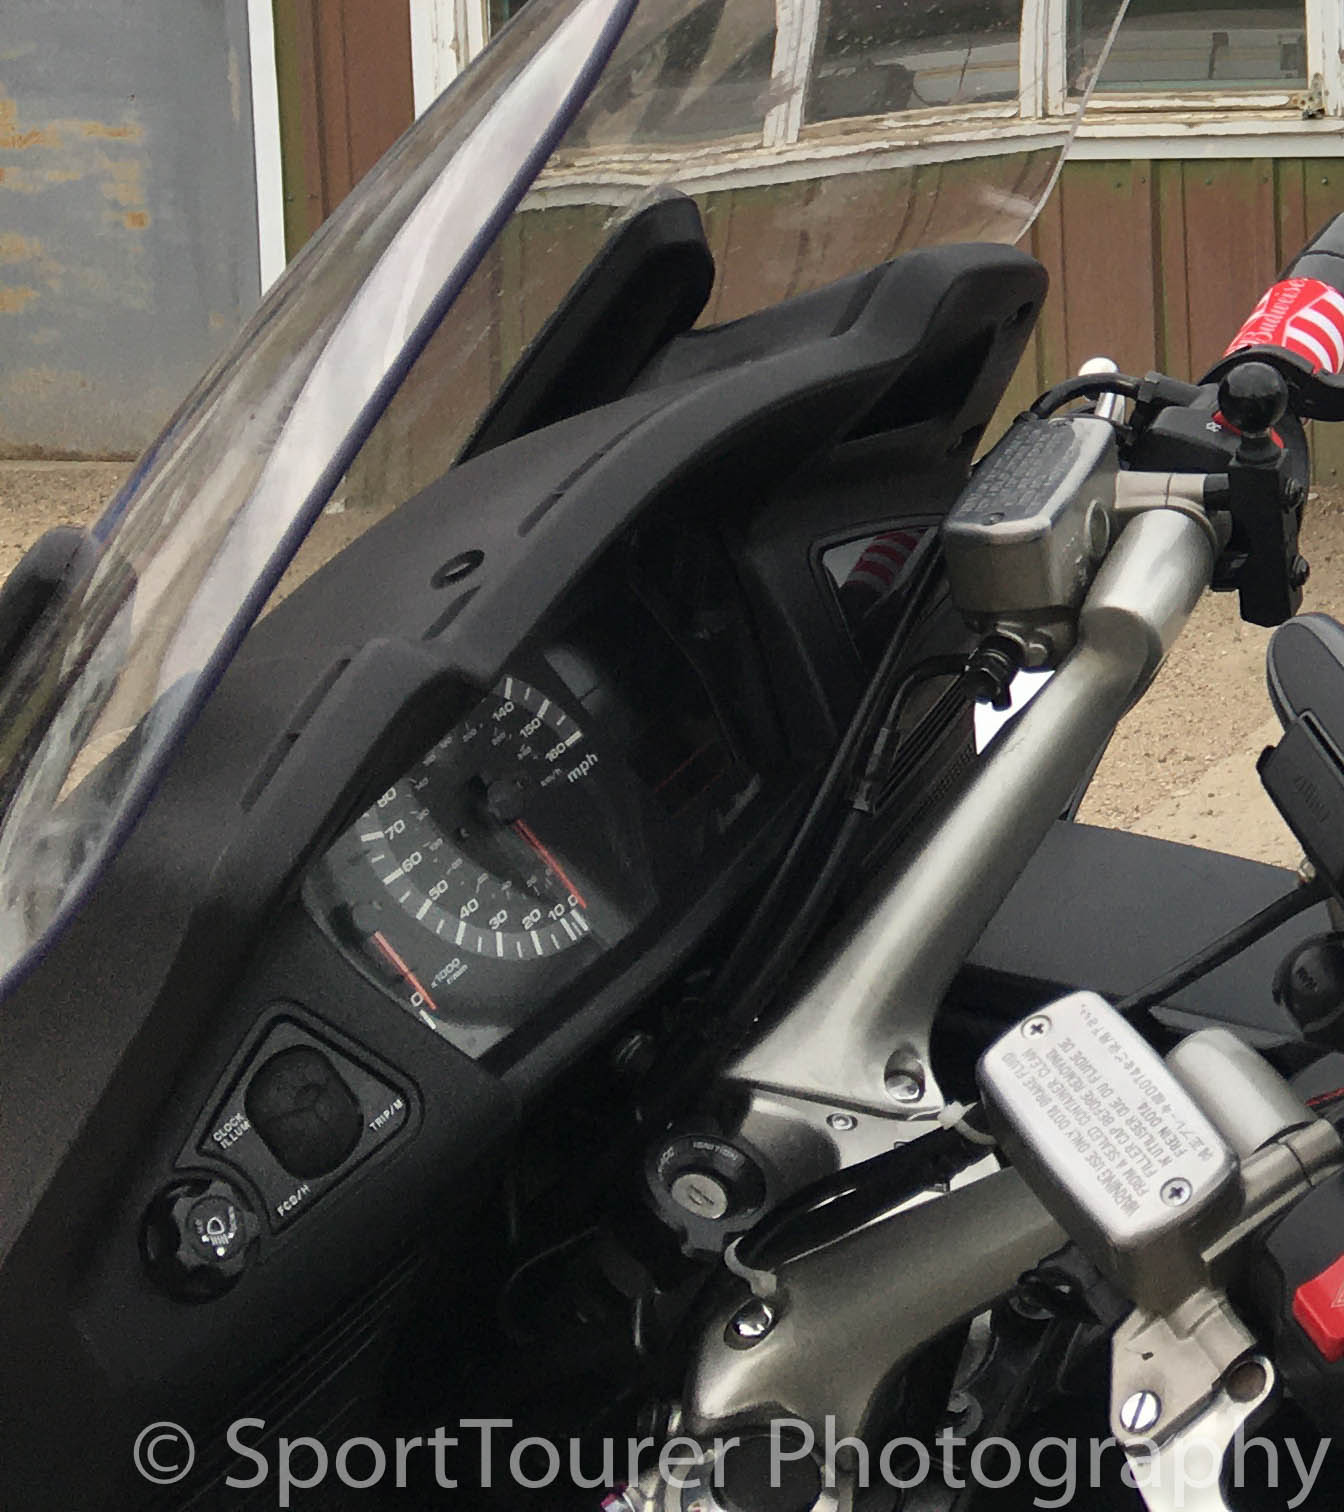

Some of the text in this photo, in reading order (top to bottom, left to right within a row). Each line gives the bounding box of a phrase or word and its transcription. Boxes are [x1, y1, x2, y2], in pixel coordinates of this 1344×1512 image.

[492, 701, 515, 722] 140
[519, 718, 541, 739] 150
[544, 742, 567, 763] 160
[567, 753, 599, 783] mph
[377, 787, 397, 809] 80
[384, 820, 406, 840] 70
[401, 852, 422, 873] 60
[429, 880, 449, 901] 50
[460, 898, 480, 919] 40
[488, 909, 508, 930] 30
[521, 908, 541, 930] 20
[547, 903, 566, 921] 10
[410, 991, 424, 1007] 0
[368, 1098, 404, 1131] TRIP/M
[1081, 1090, 1114, 1127] BEFORE
[213, 1113, 245, 1143] CLOCK
[1021, 1046, 1150, 1197] FROM A SEALED CONTAINER CLEAN
[219, 1120, 252, 1149] ILLUM
[1065, 1127, 1090, 1154] ONLY
[1109, 1123, 1129, 1145] CAP
[1157, 1124, 1187, 1158] FREIN
[1084, 1150, 1106, 1173] USE
[1124, 1141, 1157, 1179] FILLER
[1096, 1167, 1140, 1217] WARNING
